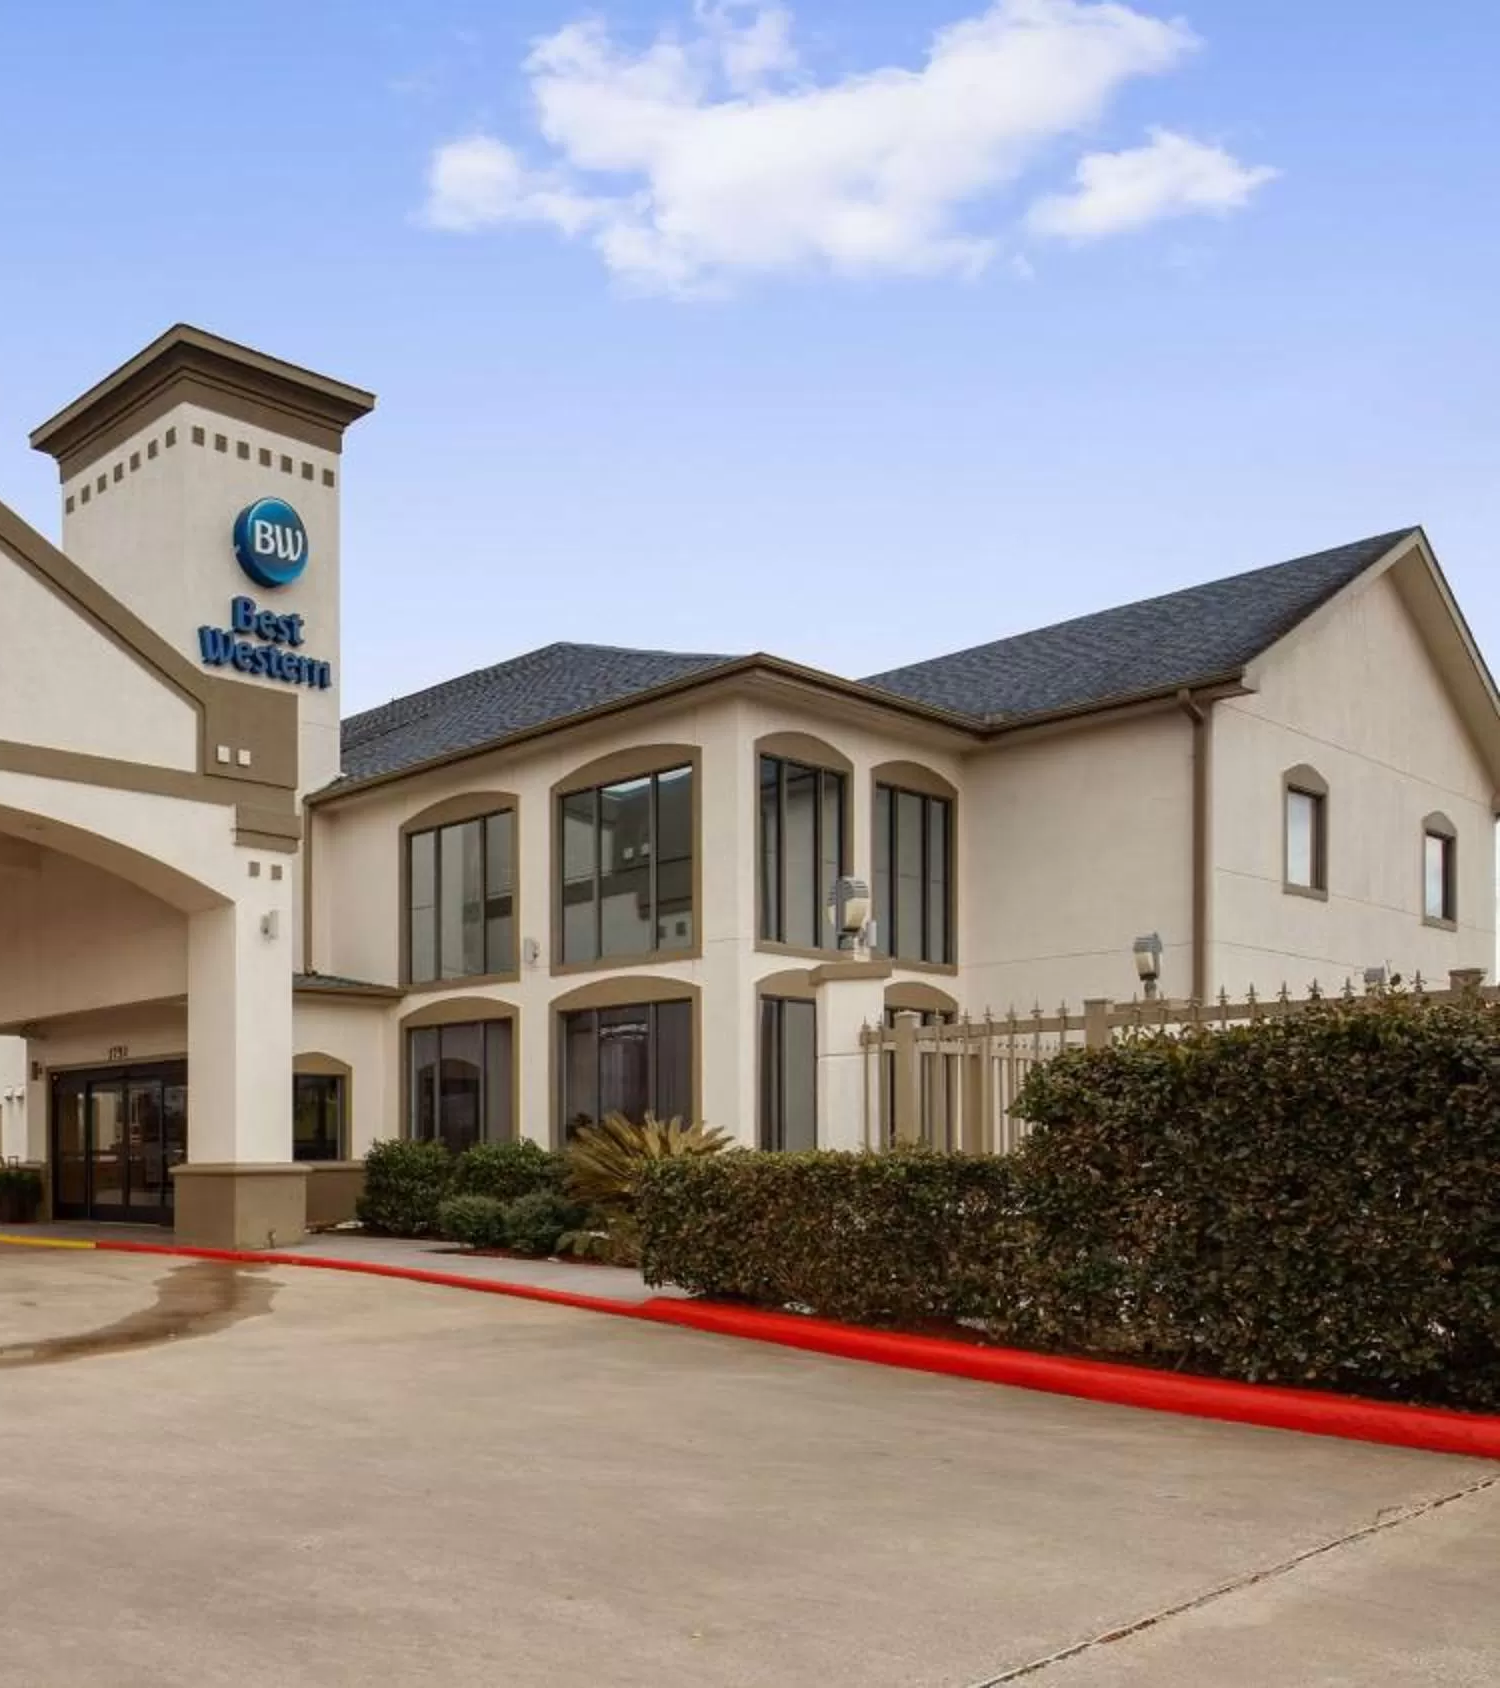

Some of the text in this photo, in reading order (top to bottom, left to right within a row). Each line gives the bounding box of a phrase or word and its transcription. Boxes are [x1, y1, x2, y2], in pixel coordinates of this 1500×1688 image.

[254, 520, 303, 561] BW
[232, 596, 304, 647] Best
[198, 625, 332, 689] Western
